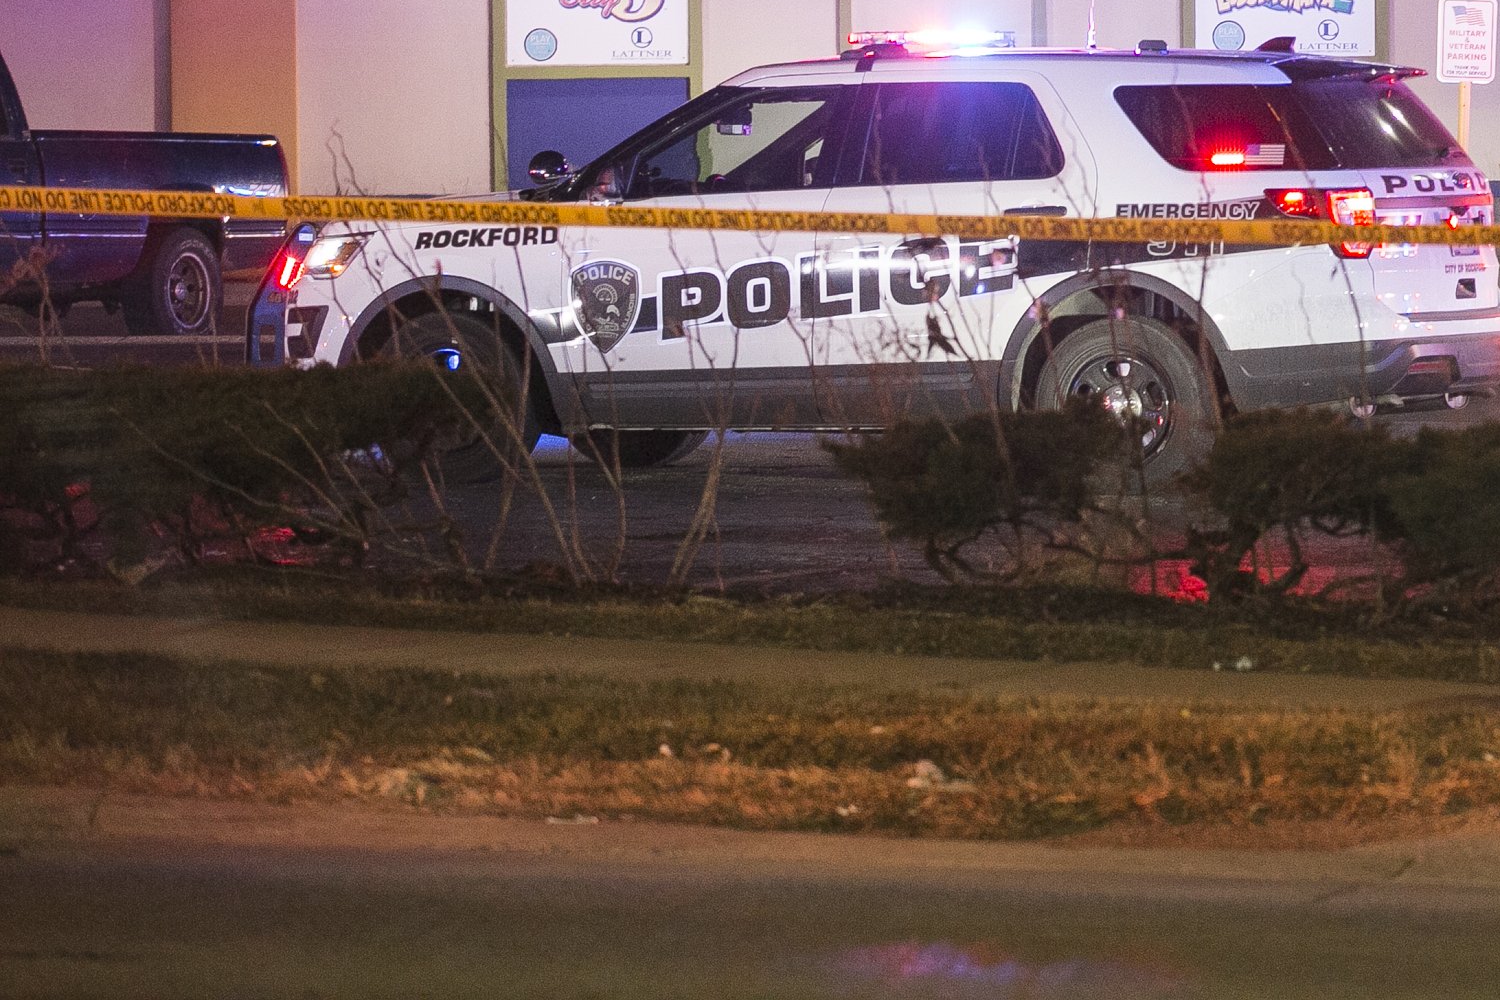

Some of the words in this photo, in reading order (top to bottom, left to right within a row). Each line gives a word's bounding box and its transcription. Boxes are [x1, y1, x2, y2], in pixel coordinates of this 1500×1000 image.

[1449, 29, 1487, 37] MILITARY
[1447, 53, 1487, 61] PARKING
[14, 192, 42, 209] NOT
[46, 193, 66, 210] DO
[70, 193, 100, 210] LINE
[104, 194, 154, 211] POLICE
[158, 195, 236, 214] ROCKFORD
[282, 199, 330, 216] CROSS
[336, 200, 366, 217] NOT
[368, 201, 389, 218] DO
[392, 201, 422, 218] LINE
[426, 202, 476, 220] POLICE
[480, 203, 559, 222] ROCKFORD
[1116, 202, 1260, 220] EMERGENCY
[415, 226, 559, 250] ROCKFORD
[577, 265, 634, 286] POLICE
[657, 235, 1019, 343] POLICE
